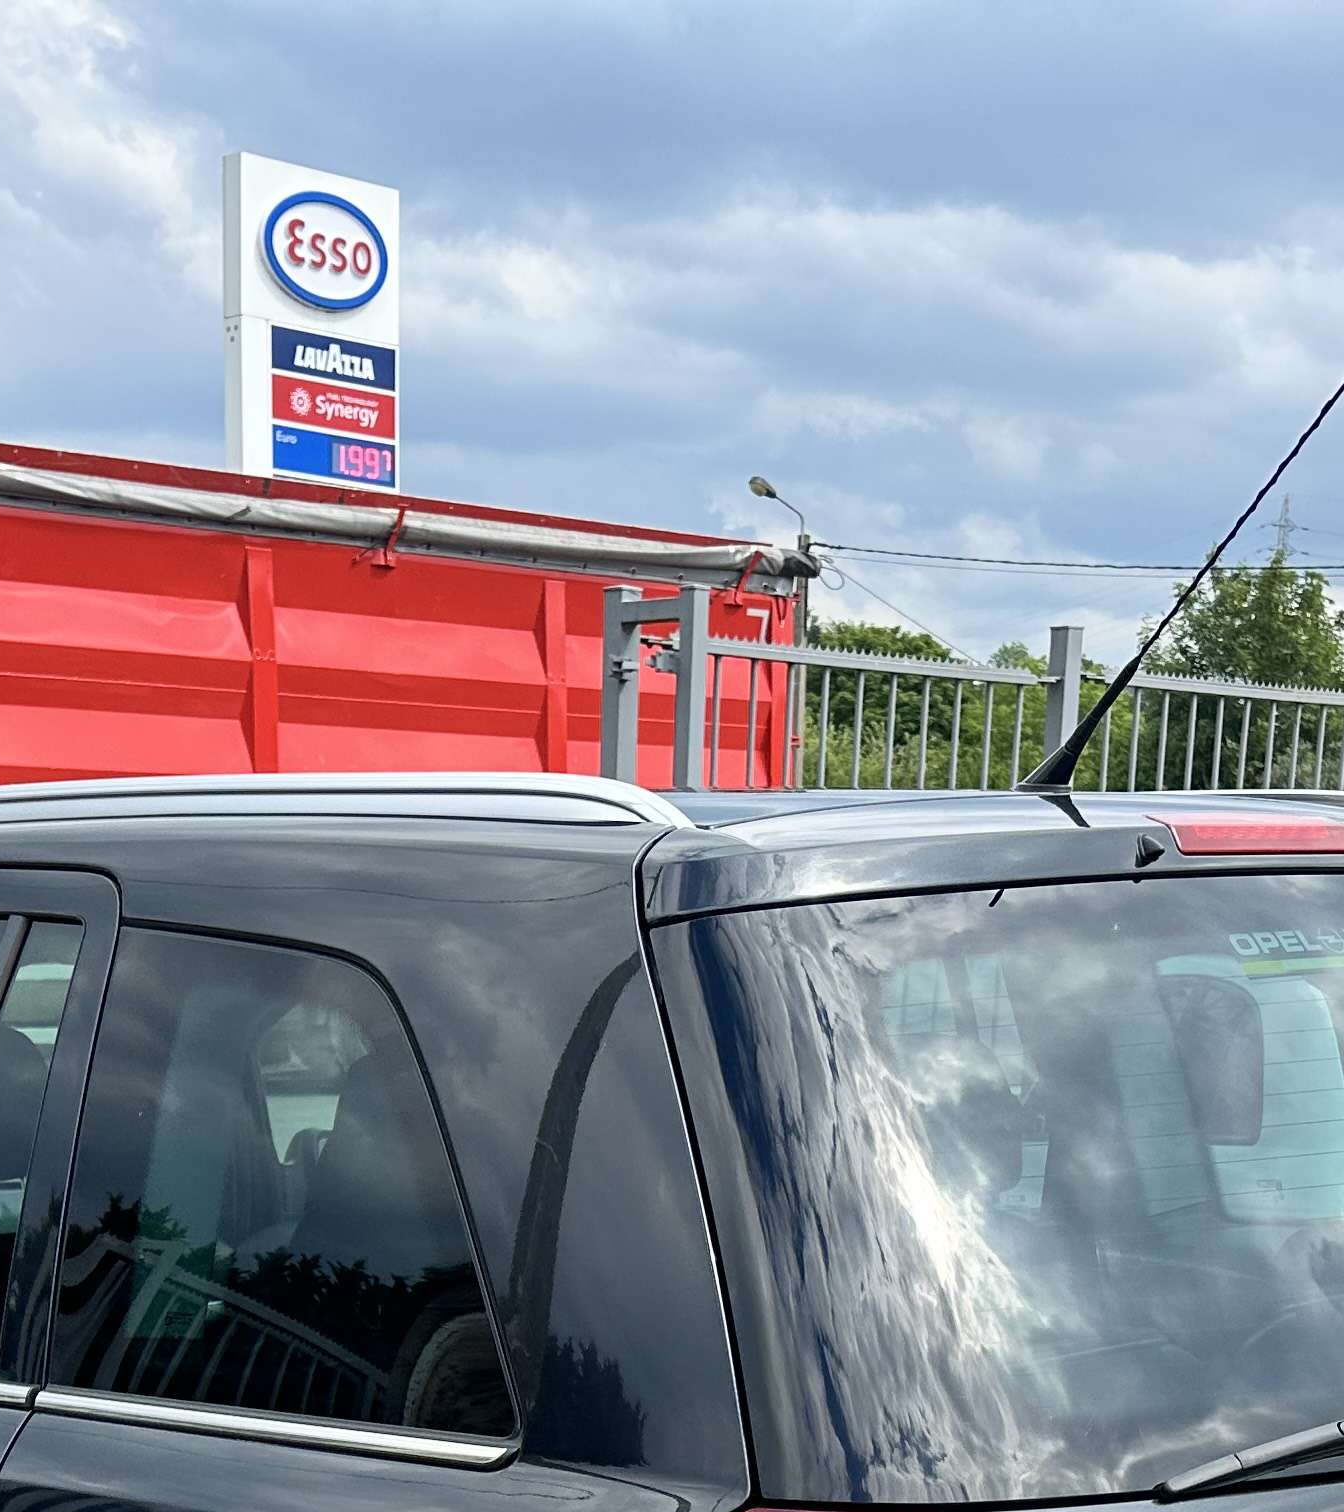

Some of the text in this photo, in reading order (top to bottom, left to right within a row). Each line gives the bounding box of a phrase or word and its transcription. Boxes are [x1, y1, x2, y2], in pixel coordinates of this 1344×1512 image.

[315, 395, 379, 428] Synergy
[276, 430, 297, 445] Euro
[1229, 930, 1322, 956] OPEL
